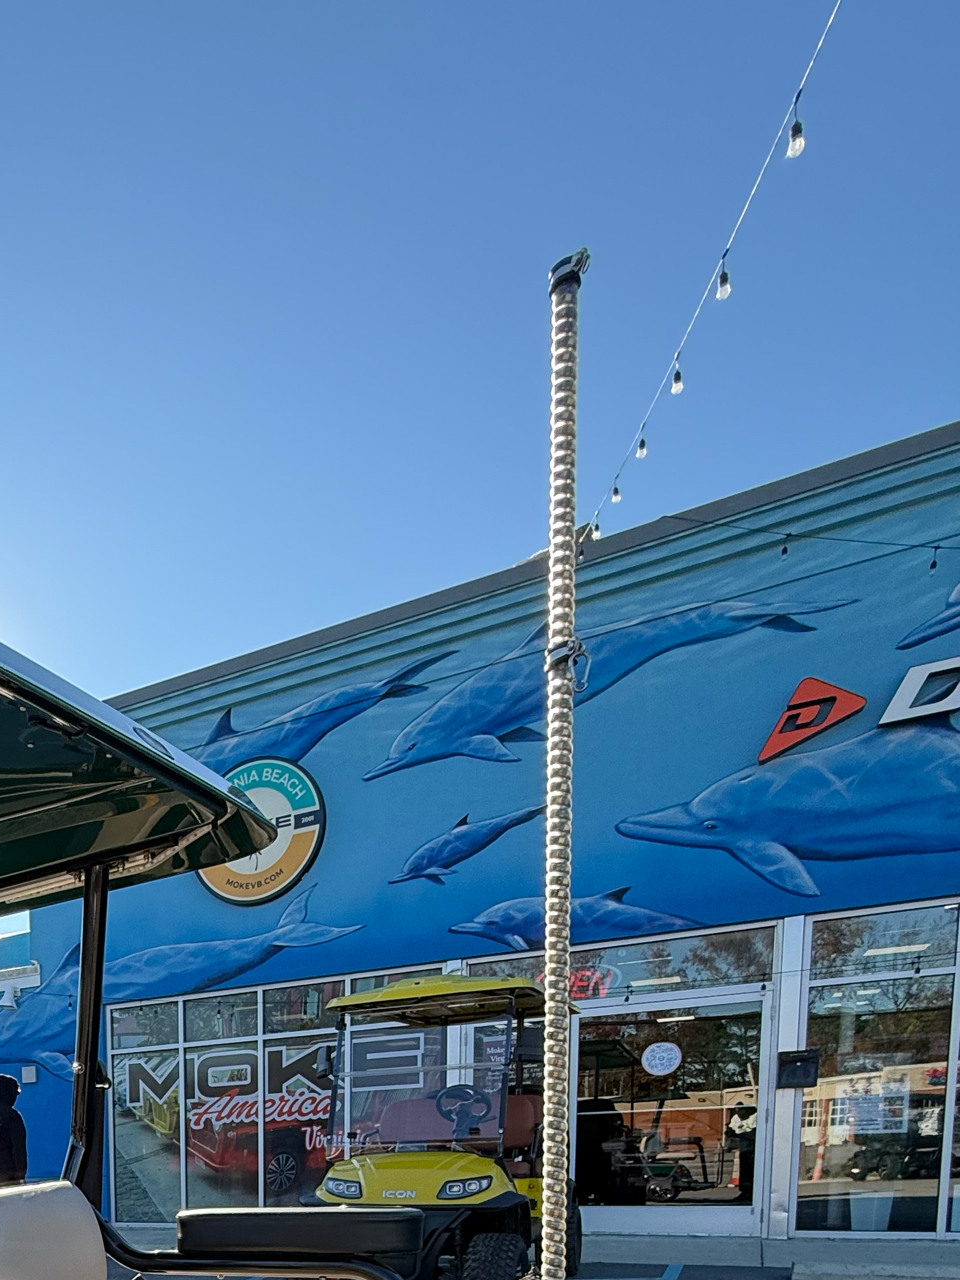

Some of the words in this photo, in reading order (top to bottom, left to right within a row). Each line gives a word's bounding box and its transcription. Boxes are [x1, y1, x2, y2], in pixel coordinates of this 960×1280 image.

[262, 768, 307, 800] BEACH
[226, 868, 284, 890] MOKEVB.COM
[126, 1033, 425, 1106] MOKE
[191, 1086, 341, 1129] America
[382, 1190, 417, 1199] ICON
